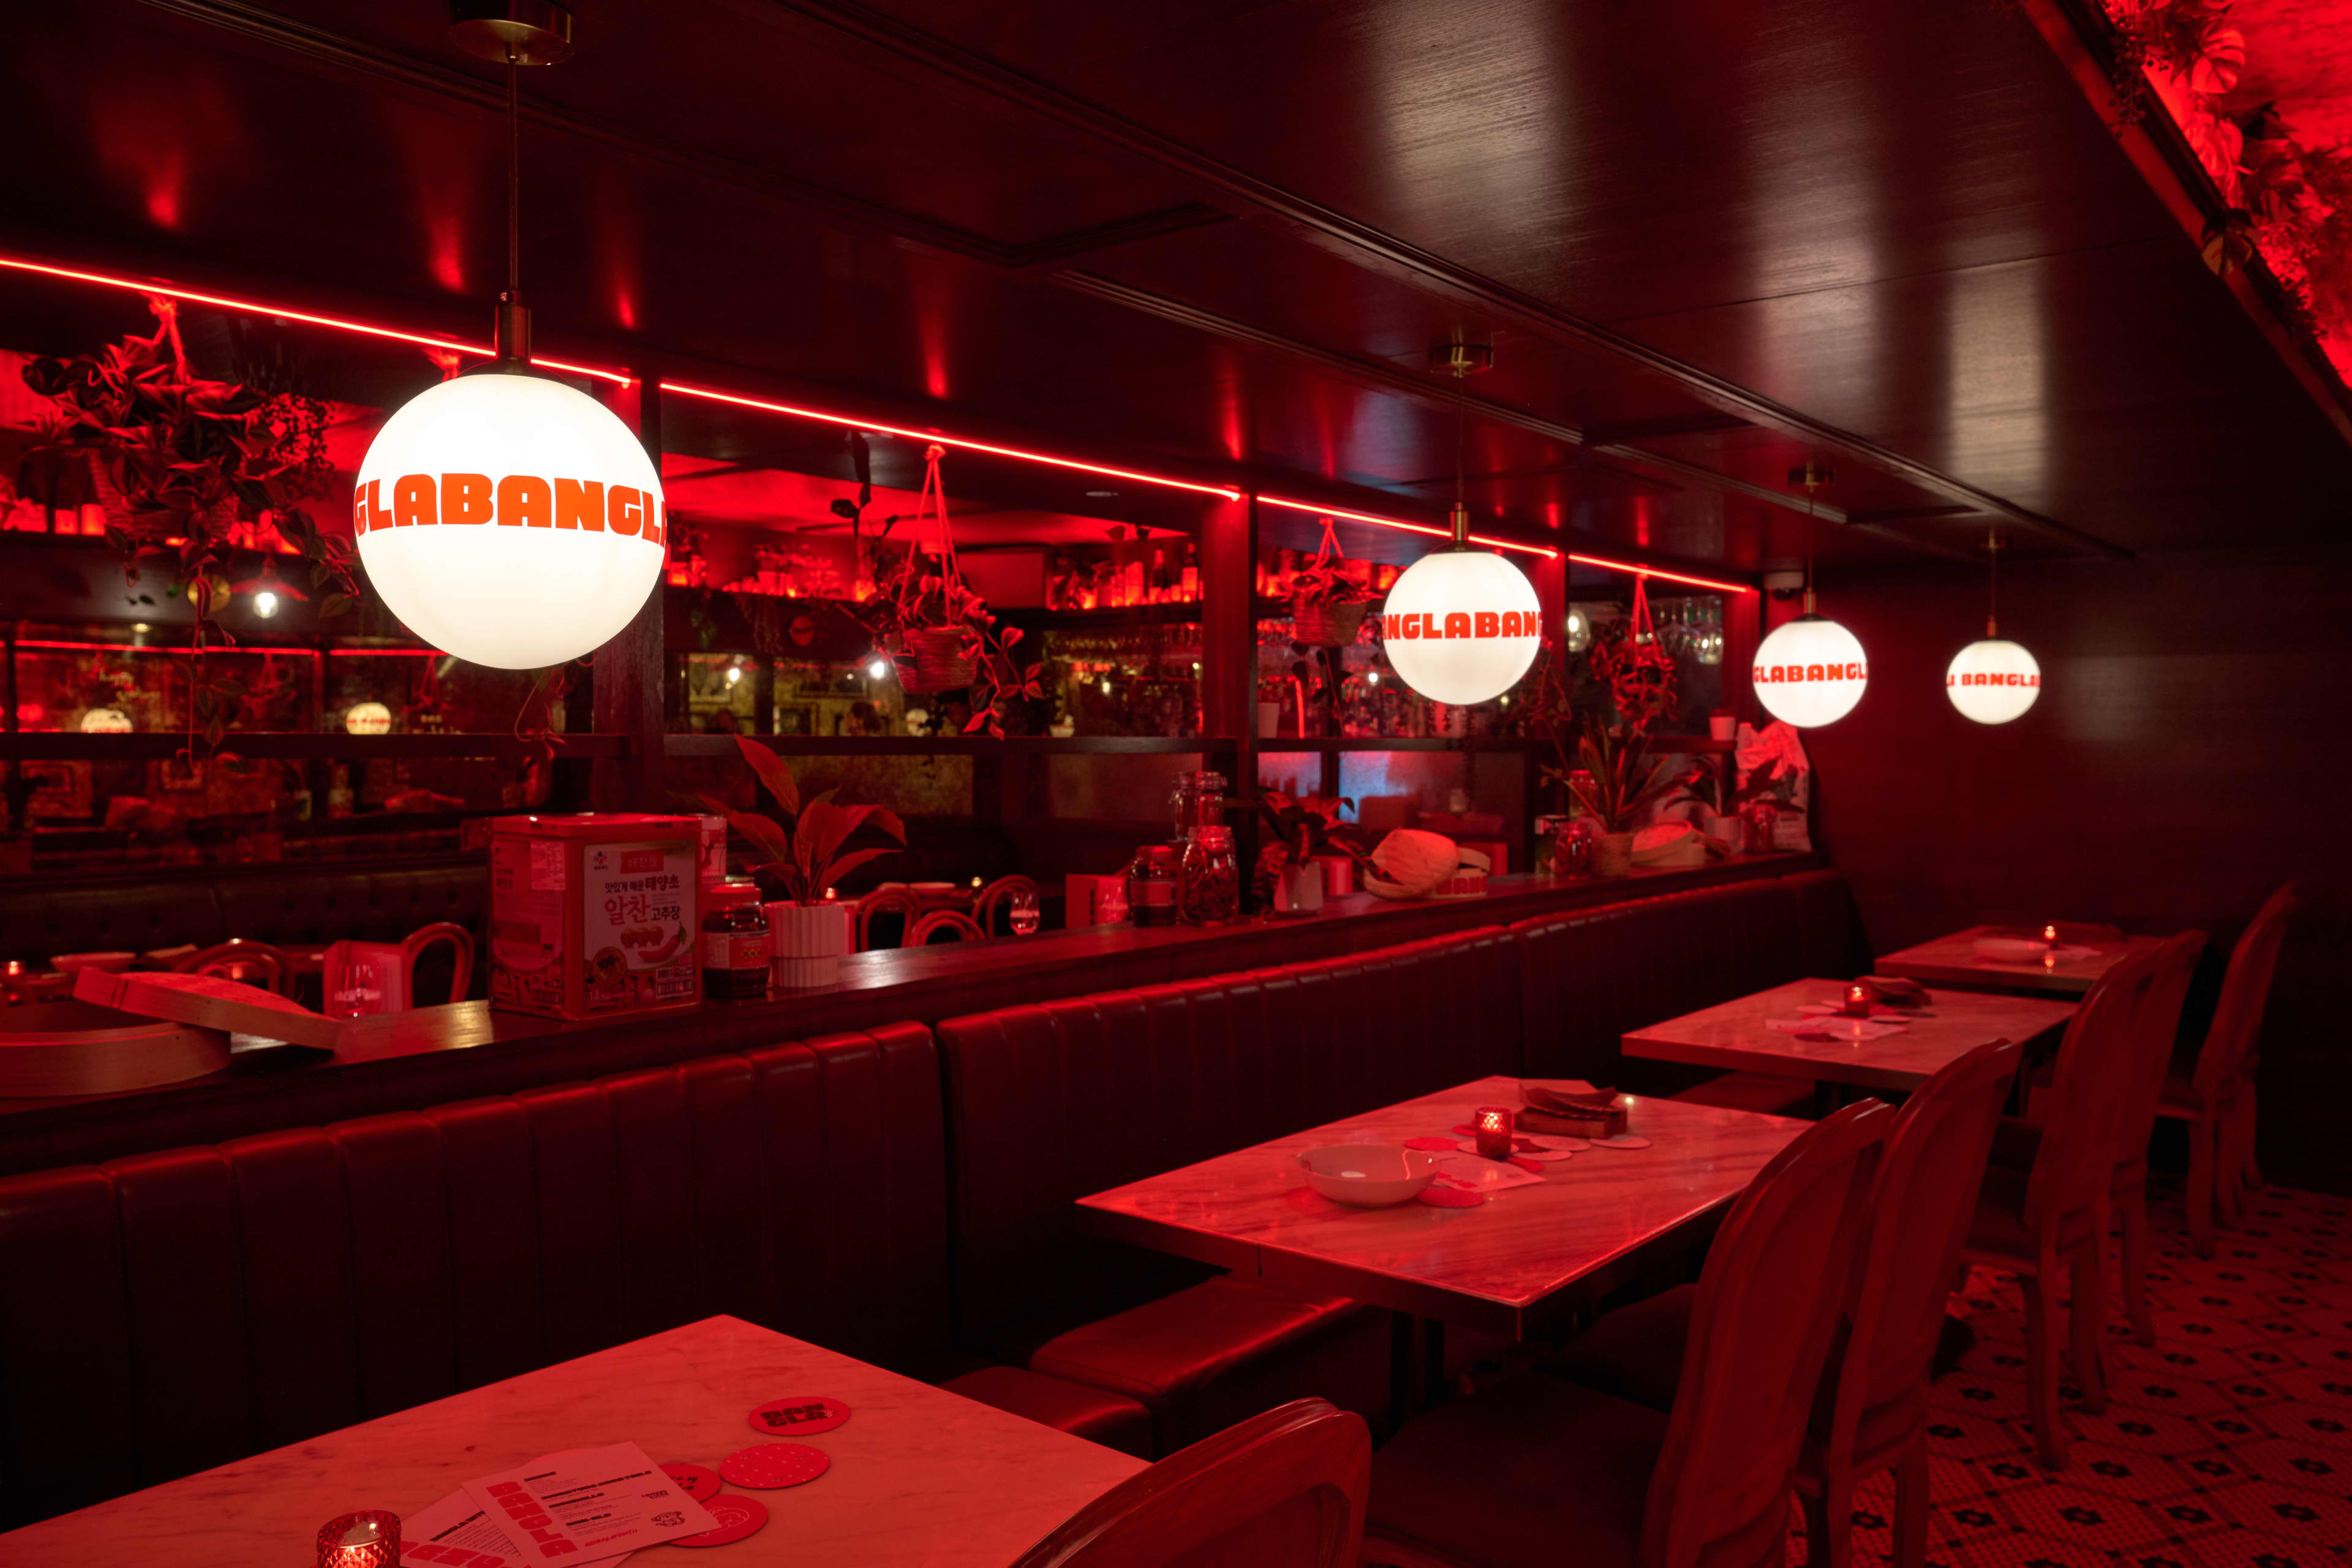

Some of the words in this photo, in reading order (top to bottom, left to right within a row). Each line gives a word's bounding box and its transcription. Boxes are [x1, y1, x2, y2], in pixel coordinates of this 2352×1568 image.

[1753, 663, 1868, 683] GLABANGL
[645, 874, 679, 891] 태양초
[605, 894, 650, 925] 알찬
[650, 905, 680, 921] 고추장
